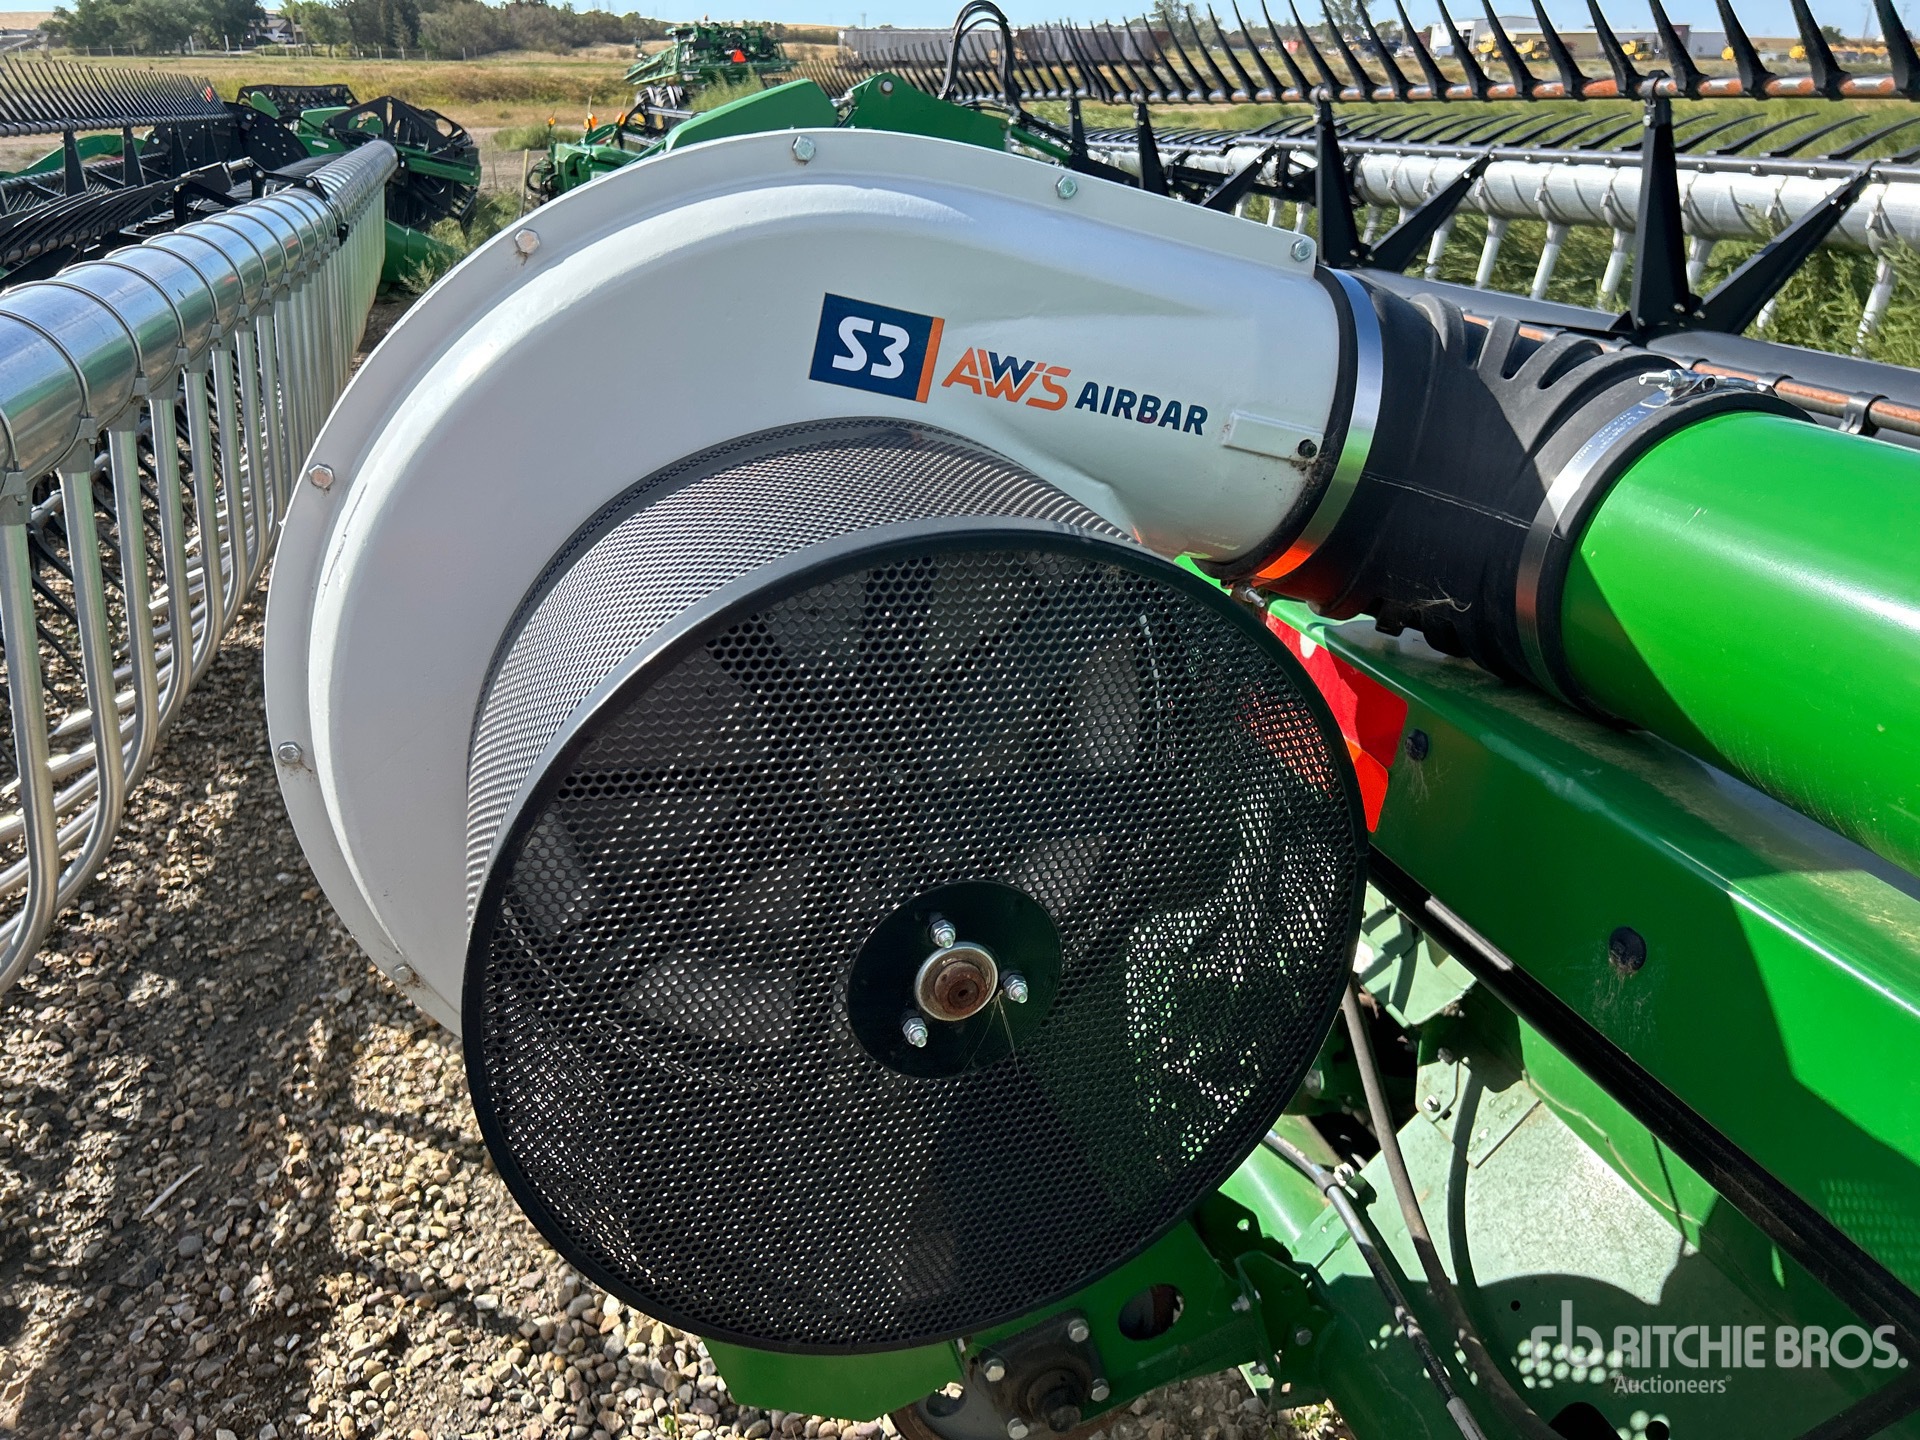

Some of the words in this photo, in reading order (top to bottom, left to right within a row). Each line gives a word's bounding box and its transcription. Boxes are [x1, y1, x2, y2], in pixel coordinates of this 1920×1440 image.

[832, 316, 911, 380] S3
[941, 346, 1072, 412] AWS
[1074, 381, 1209, 436] AIRBAR
